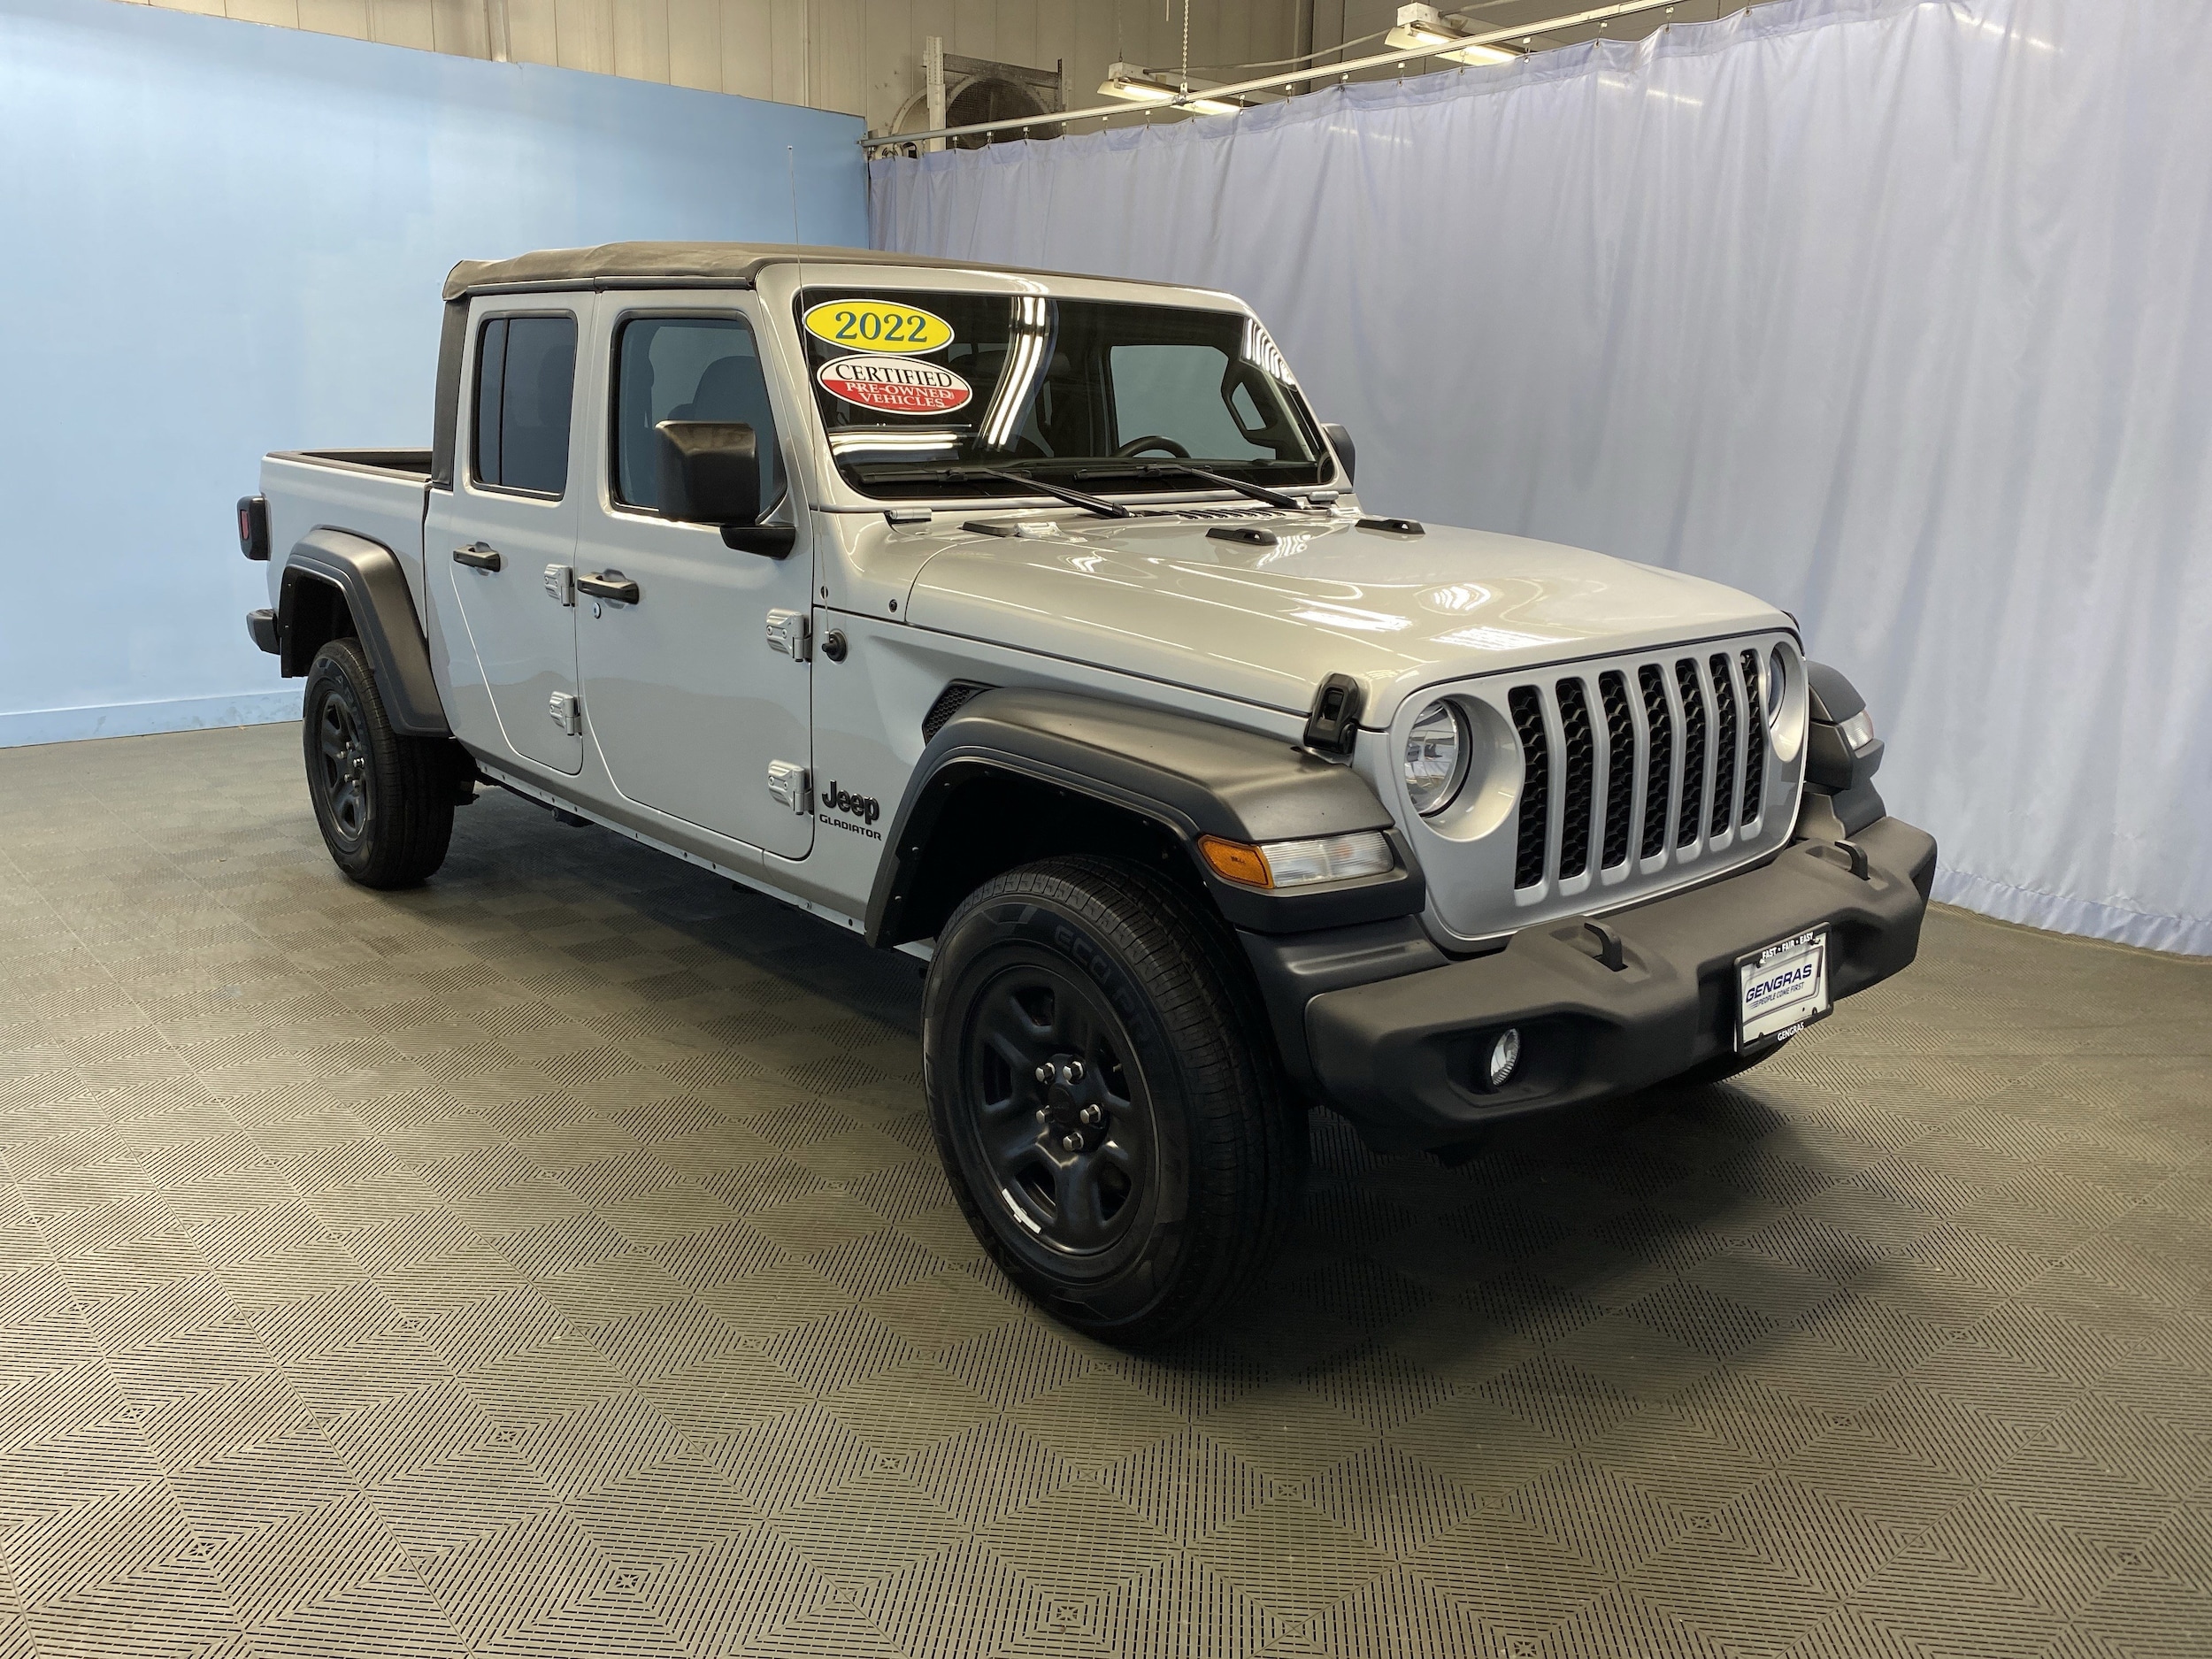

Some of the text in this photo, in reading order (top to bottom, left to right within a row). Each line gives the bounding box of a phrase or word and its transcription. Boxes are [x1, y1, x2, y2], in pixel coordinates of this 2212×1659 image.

[835, 311, 928, 342] 2022
[835, 364, 953, 388] CERTIFIED
[845, 381, 951, 399] PRE-OWNED
[858, 392, 945, 408] VEHICLES
[821, 779, 880, 826] Jeep
[819, 813, 882, 841] GLADIATOR
[1762, 932, 1814, 959] FAST FAIR EASY
[1746, 964, 1812, 1003] GENGRAS
[1758, 992, 1776, 1008] PEOPLE
[1790, 981, 1805, 993] FIRST
[1777, 1021, 1804, 1041] GENGRAS
